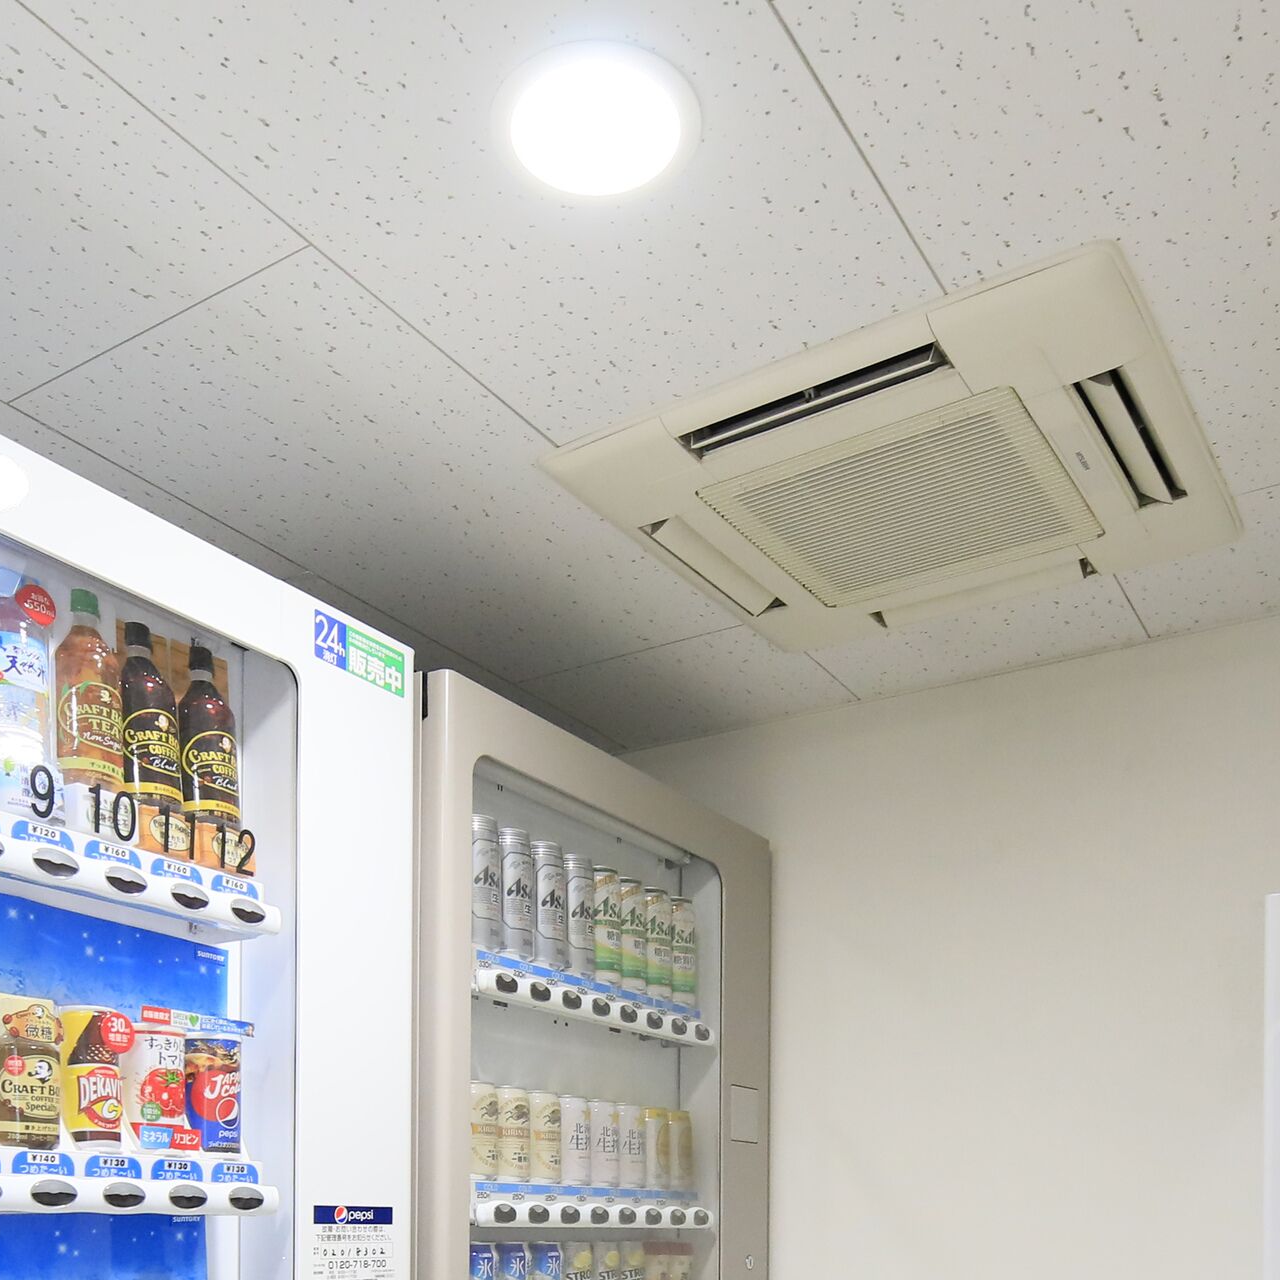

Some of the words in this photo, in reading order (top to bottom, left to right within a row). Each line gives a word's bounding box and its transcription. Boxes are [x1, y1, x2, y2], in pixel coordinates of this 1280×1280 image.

[348, 645, 403, 692] 販売中
[124, 727, 167, 744] CRAFT
[150, 756, 178, 771] Black
[188, 749, 230, 764] CRAFT
[30, 764, 56, 819] 9
[88, 783, 137, 842] 10
[31, 824, 58, 840] ¥120
[158, 807, 196, 860] 11
[103, 844, 127, 858] ¥160
[214, 823, 256, 877] 12
[166, 862, 188, 875] ¥160
[224, 878, 245, 891] ¥160
[24, 1024, 54, 1041] 微糖
[1, 1080, 48, 1095] CRAFT
[142, 1130, 170, 1144] ミネラル
[173, 1132, 199, 1145] リコピン
[30, 1153, 57, 1164] ¥140
[101, 1158, 126, 1168] ¥130
[167, 1162, 189, 1171] ¥130
[226, 1166, 246, 1174] ¥130
[348, 1209, 375, 1222] pepsi
[328, 1260, 387, 1270] 0120-718-700
[477, 1259, 492, 1279] 氷
